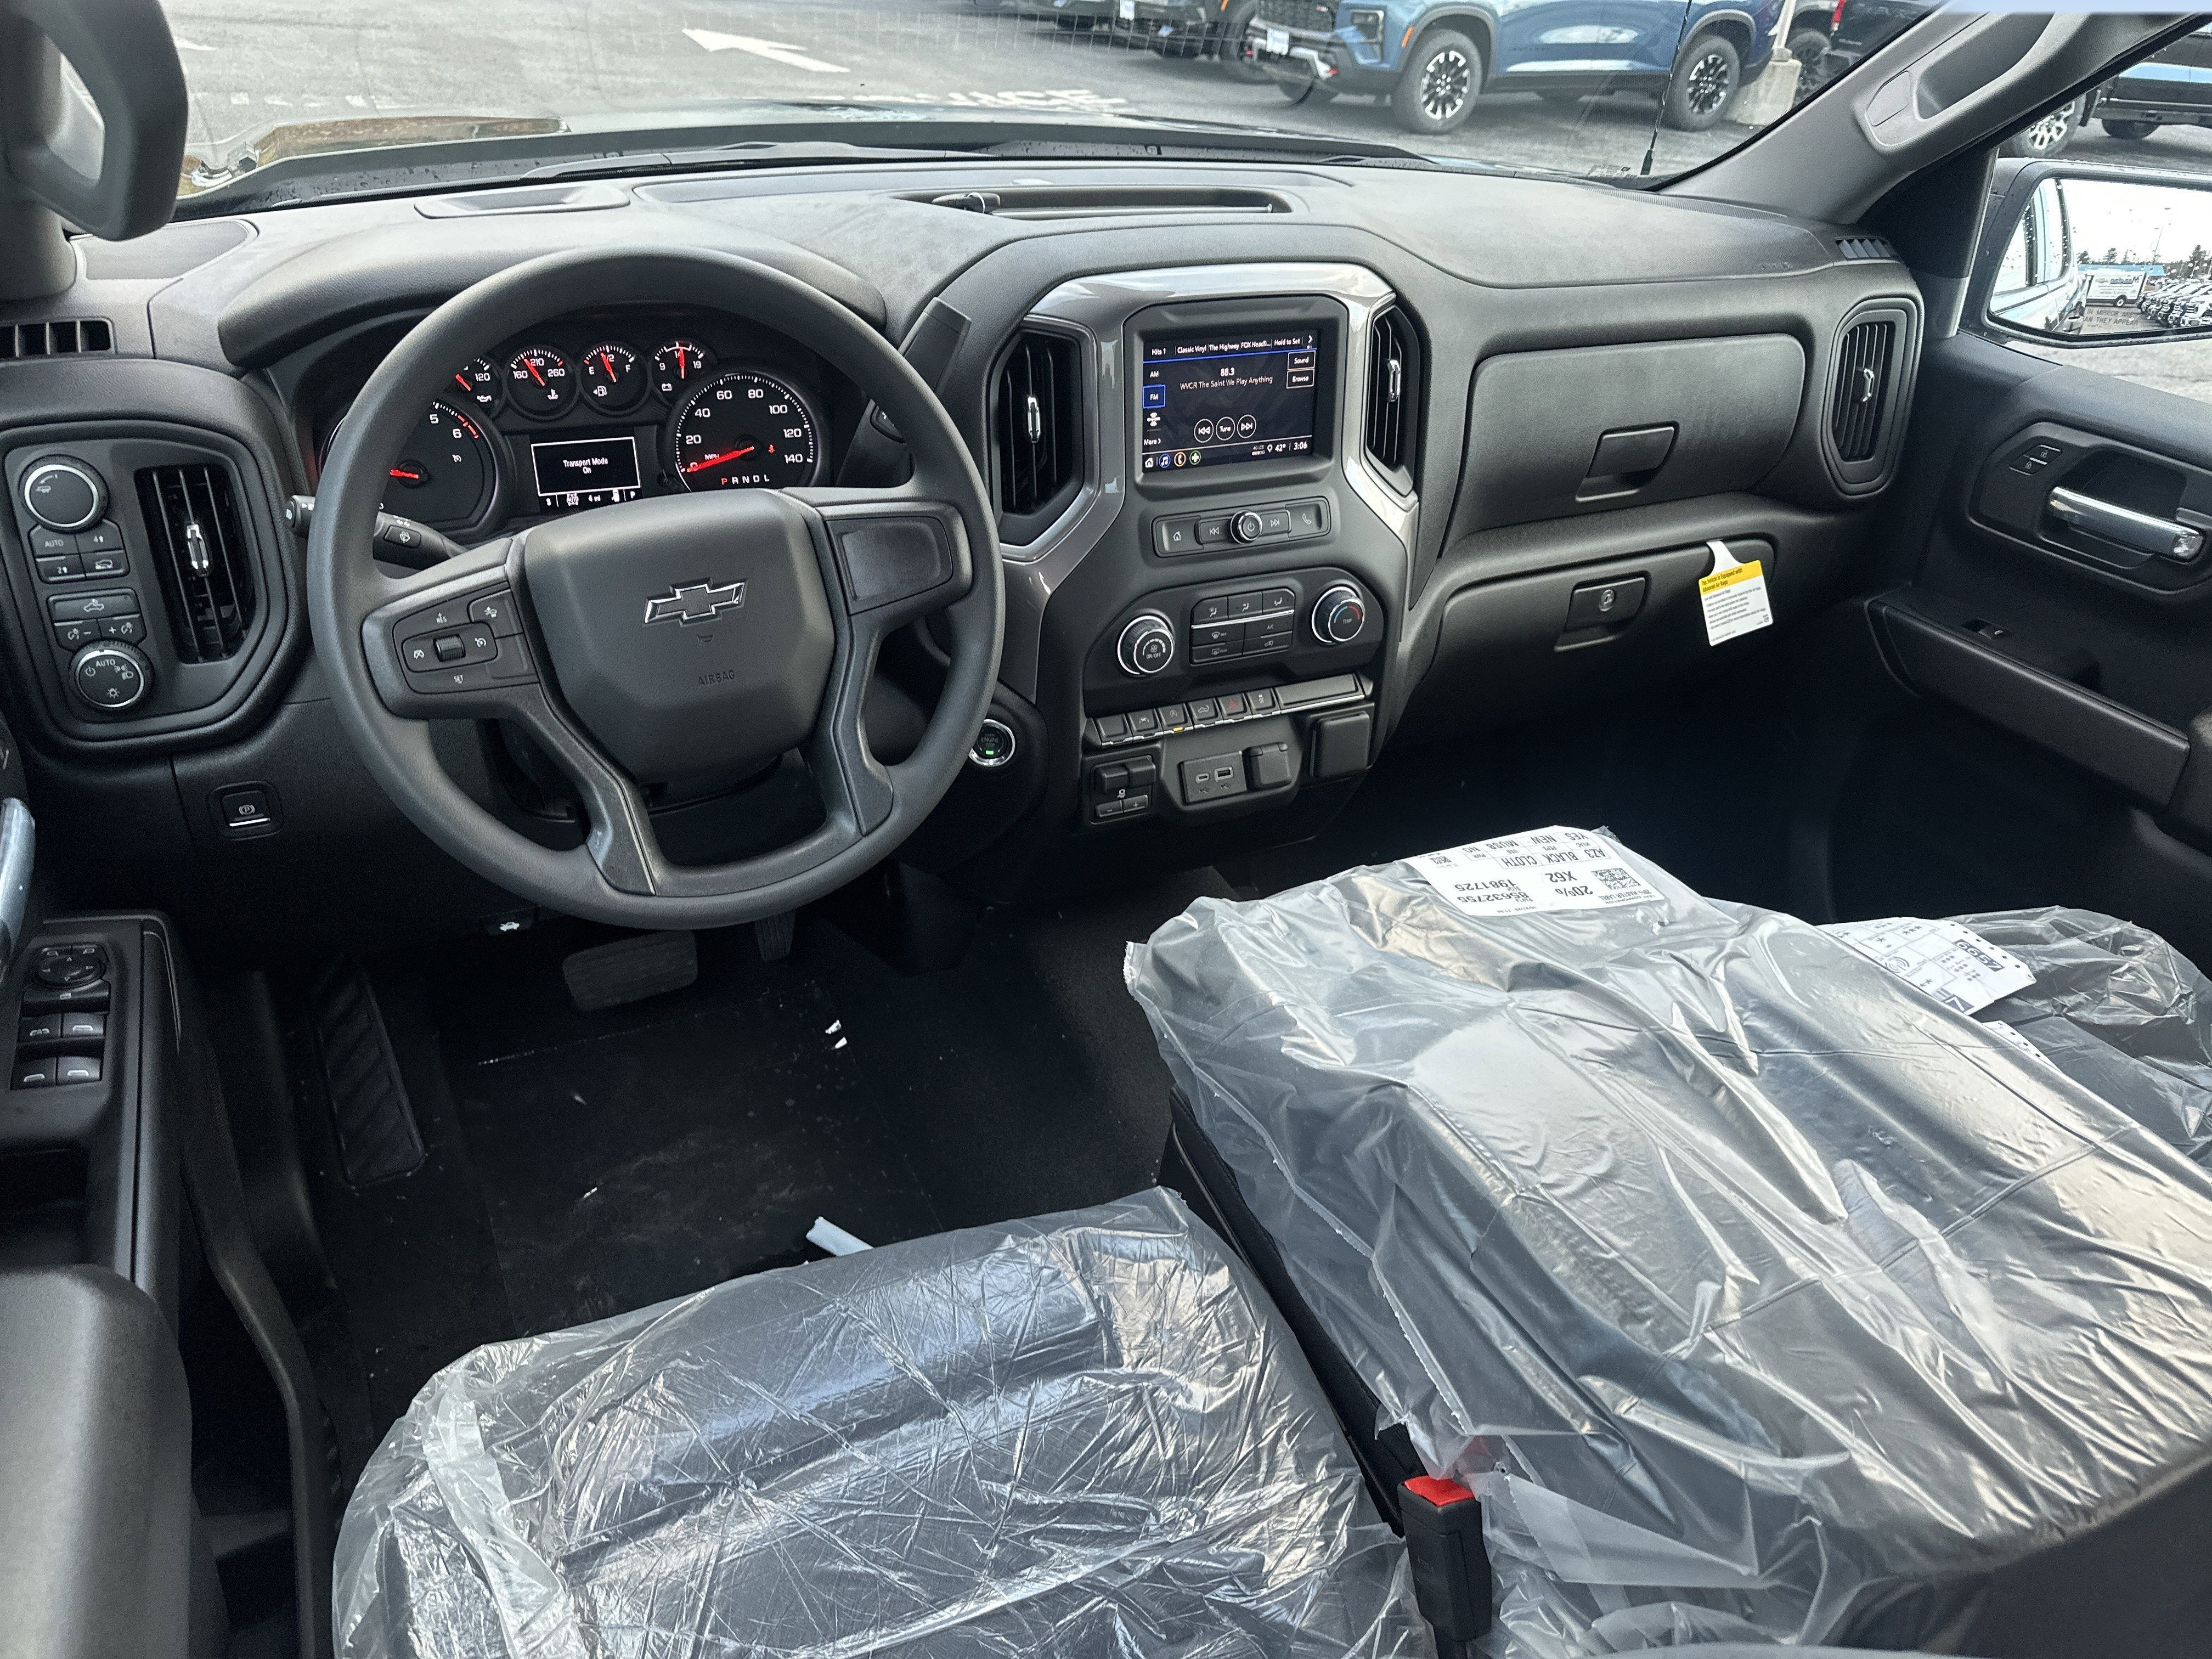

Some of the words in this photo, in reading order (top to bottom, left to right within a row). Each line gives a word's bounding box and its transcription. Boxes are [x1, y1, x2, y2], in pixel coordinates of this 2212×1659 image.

[1194, 345, 1207, 353] Vinyl
[1219, 342, 1239, 352] Highway
[530, 358, 544, 366] 210
[659, 362, 665, 370] 9
[693, 360, 702, 369] 19
[548, 368, 565, 377] 260
[589, 366, 595, 375] E
[625, 364, 630, 373] F
[1220, 367, 1234, 376] 88.3
[475, 373, 490, 381] 120
[513, 370, 528, 379] 160
[1237, 377, 1247, 386] Play
[1248, 376, 1273, 386] Anything
[716, 390, 732, 400] 60
[748, 389, 764, 398] 80
[695, 408, 710, 418] 40
[769, 404, 788, 415] 100
[430, 414, 438, 424] 5
[453, 428, 462, 438] 6
[783, 428, 802, 438] 120
[686, 434, 702, 444] 20
[1294, 441, 1307, 450] 3:06
[563, 458, 591, 469] Transport
[591, 457, 608, 466] Mode
[784, 454, 803, 464] 140
[583, 466, 591, 475] On
[44, 539, 64, 548] AUTO
[95, 658, 116, 668] AUTO
[698, 670, 735, 687] AIRBAG
[1530, 834, 1557, 844] NEW
[1565, 832, 1589, 840] YES
[1486, 840, 1520, 849] MUSB
[1542, 851, 1579, 863] BLACK
[1584, 848, 1606, 858] AZ3
[1501, 855, 1538, 867] CLOTH
[1544, 871, 1578, 883] X62
[1454, 879, 1517, 891] 1981725
[1554, 885, 1593, 896] 20%
[1457, 891, 1530, 902] 85632755
[1956, 941, 2001, 968] 6657
